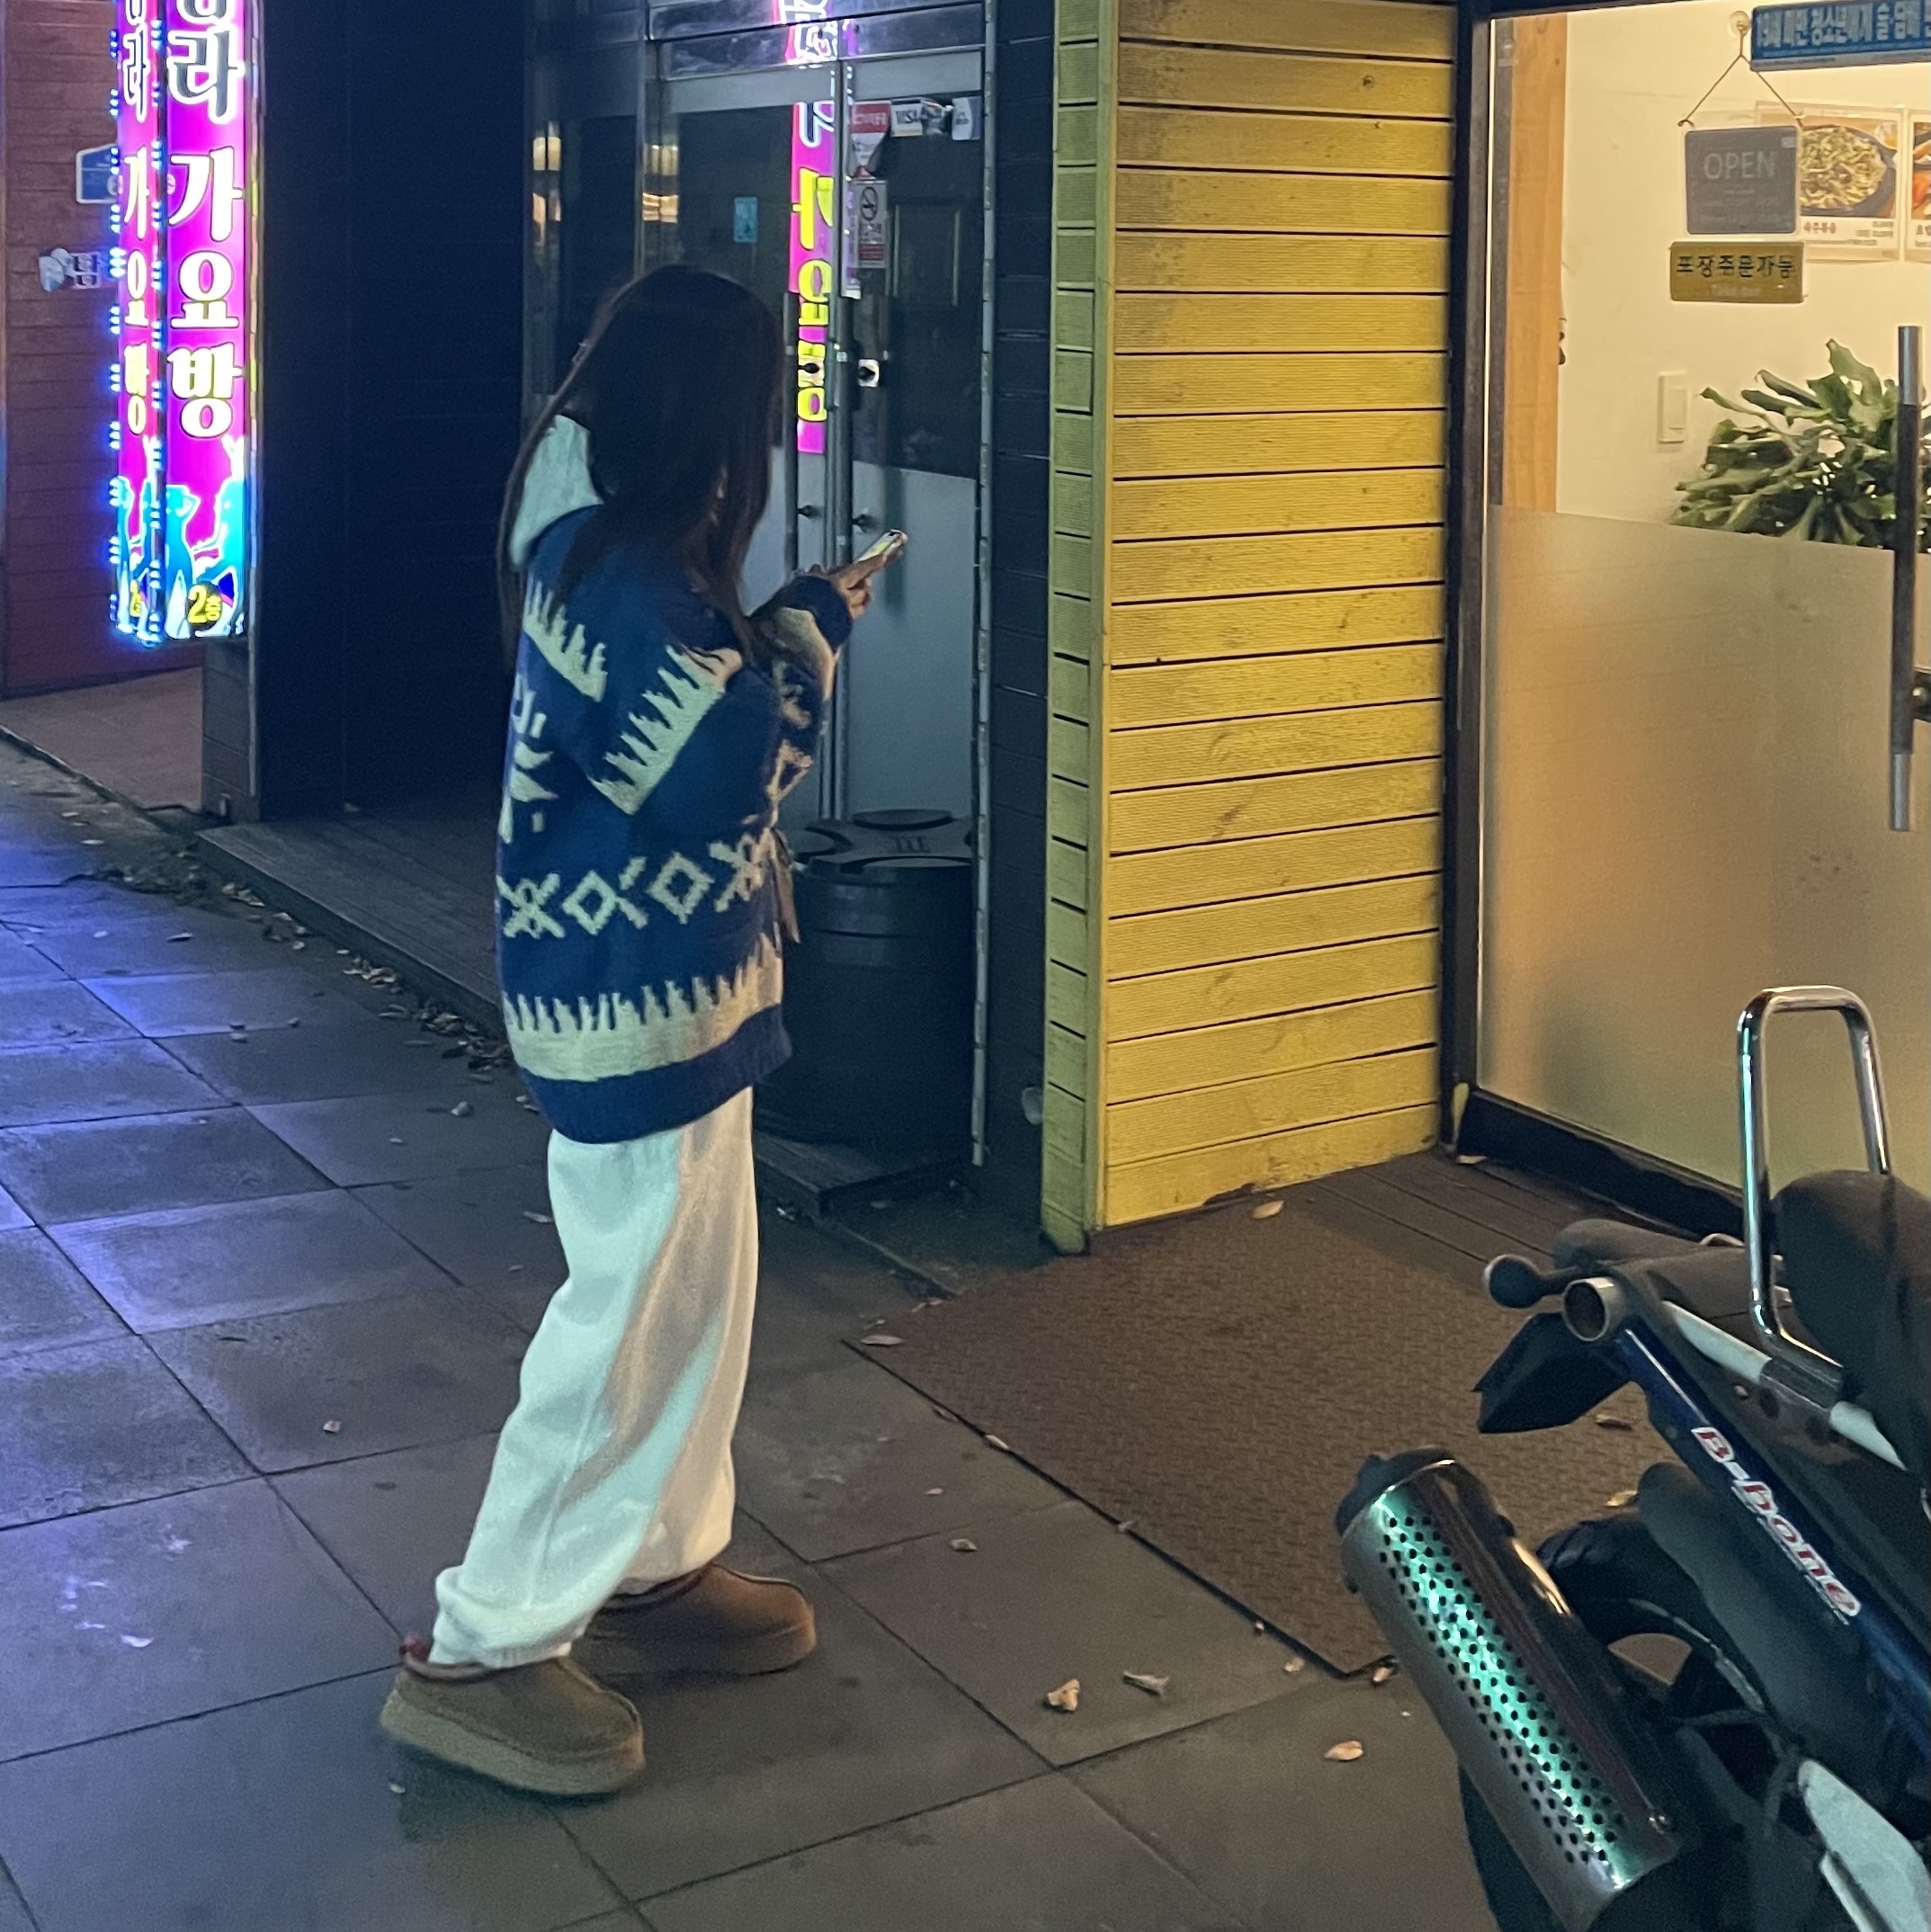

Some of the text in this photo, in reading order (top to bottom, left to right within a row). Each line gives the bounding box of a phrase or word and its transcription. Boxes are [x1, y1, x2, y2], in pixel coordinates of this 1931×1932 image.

[1703, 150, 1777, 180] OPEN
[167, 146, 244, 438] 가요방
[187, 585, 223, 624] 2층
